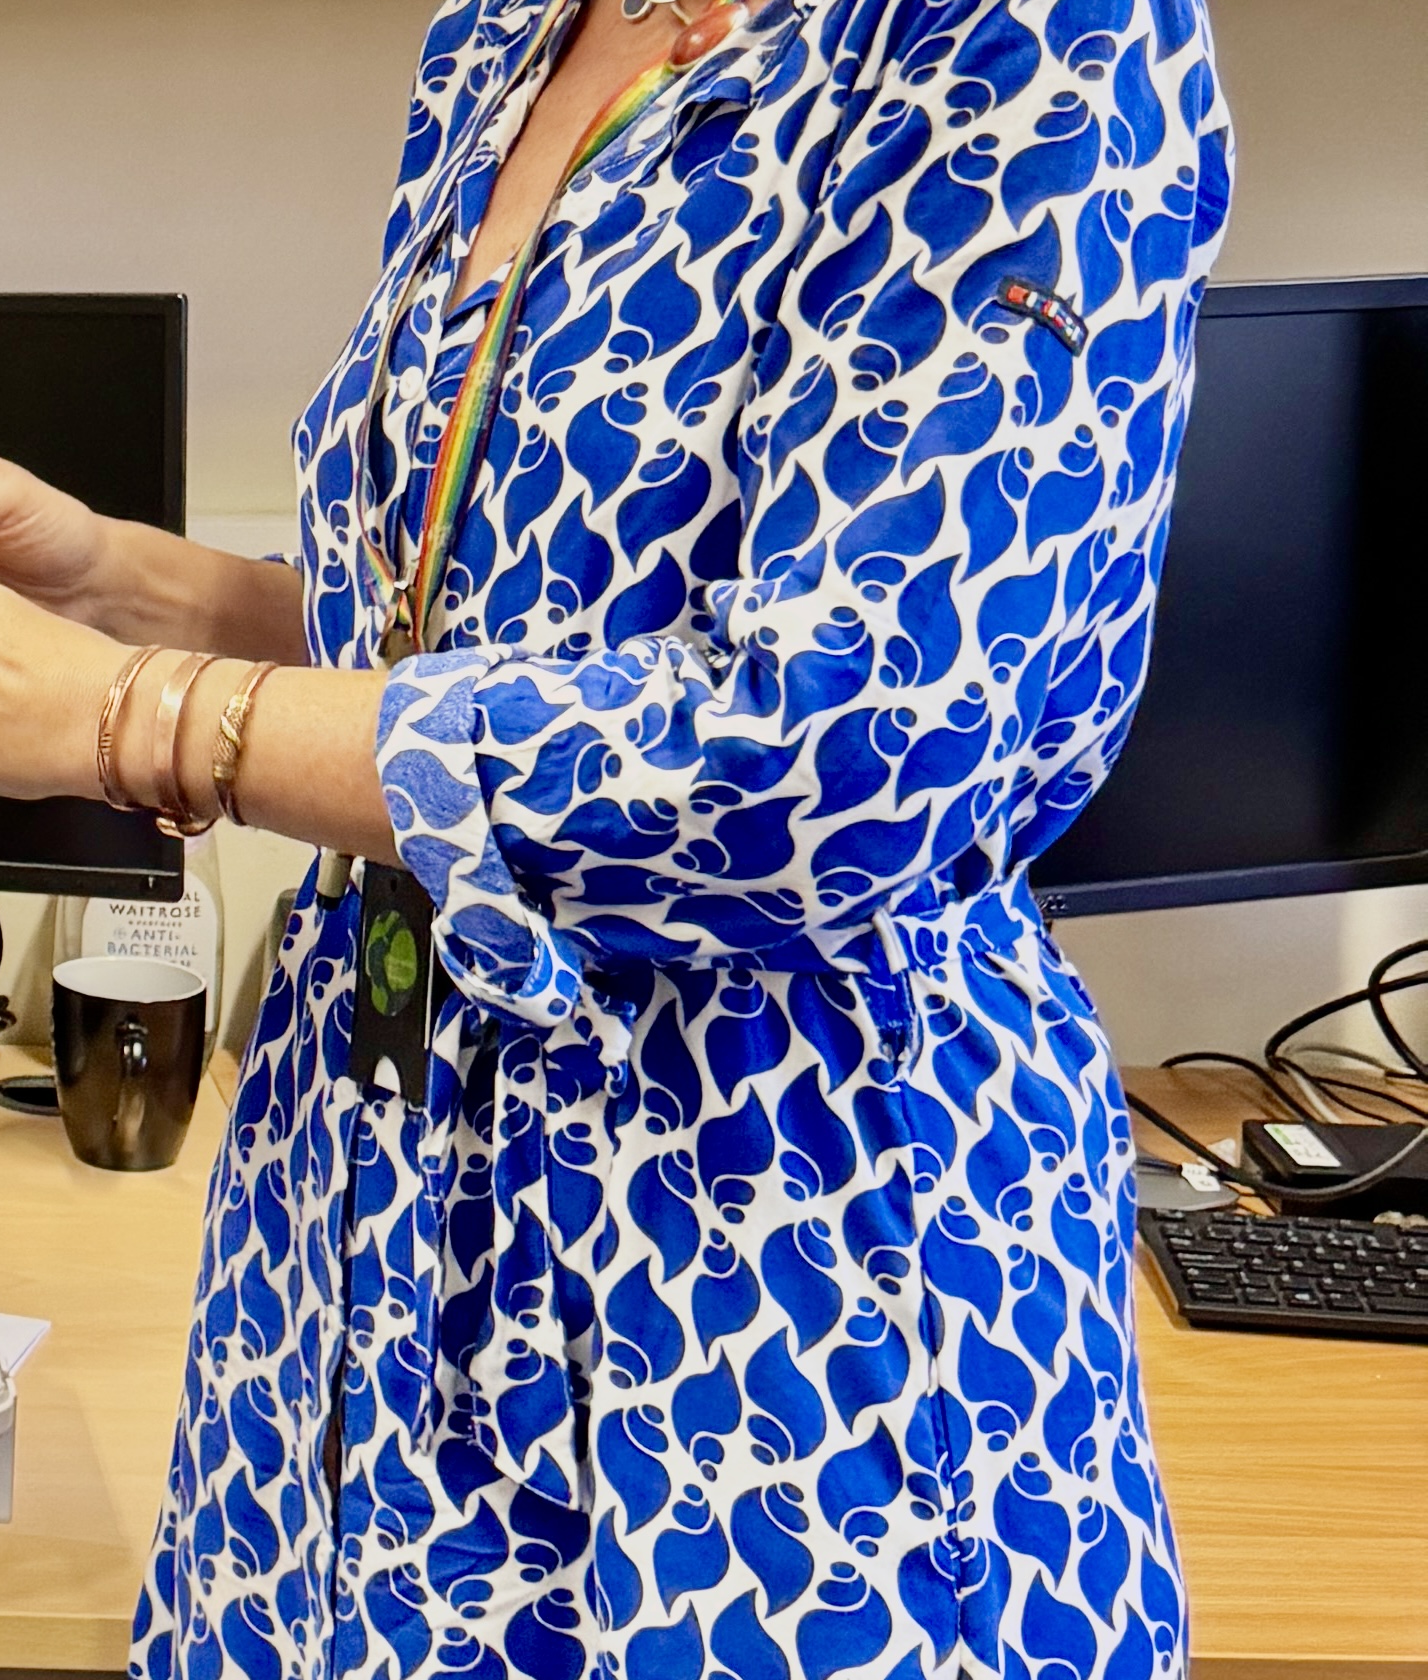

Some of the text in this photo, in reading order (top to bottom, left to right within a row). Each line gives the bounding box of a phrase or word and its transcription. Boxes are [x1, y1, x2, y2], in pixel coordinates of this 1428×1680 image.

[109, 904, 200, 918] WAITROSE
[131, 929, 180, 941] ANTI-
[107, 941, 198, 957] BACTERIAL
